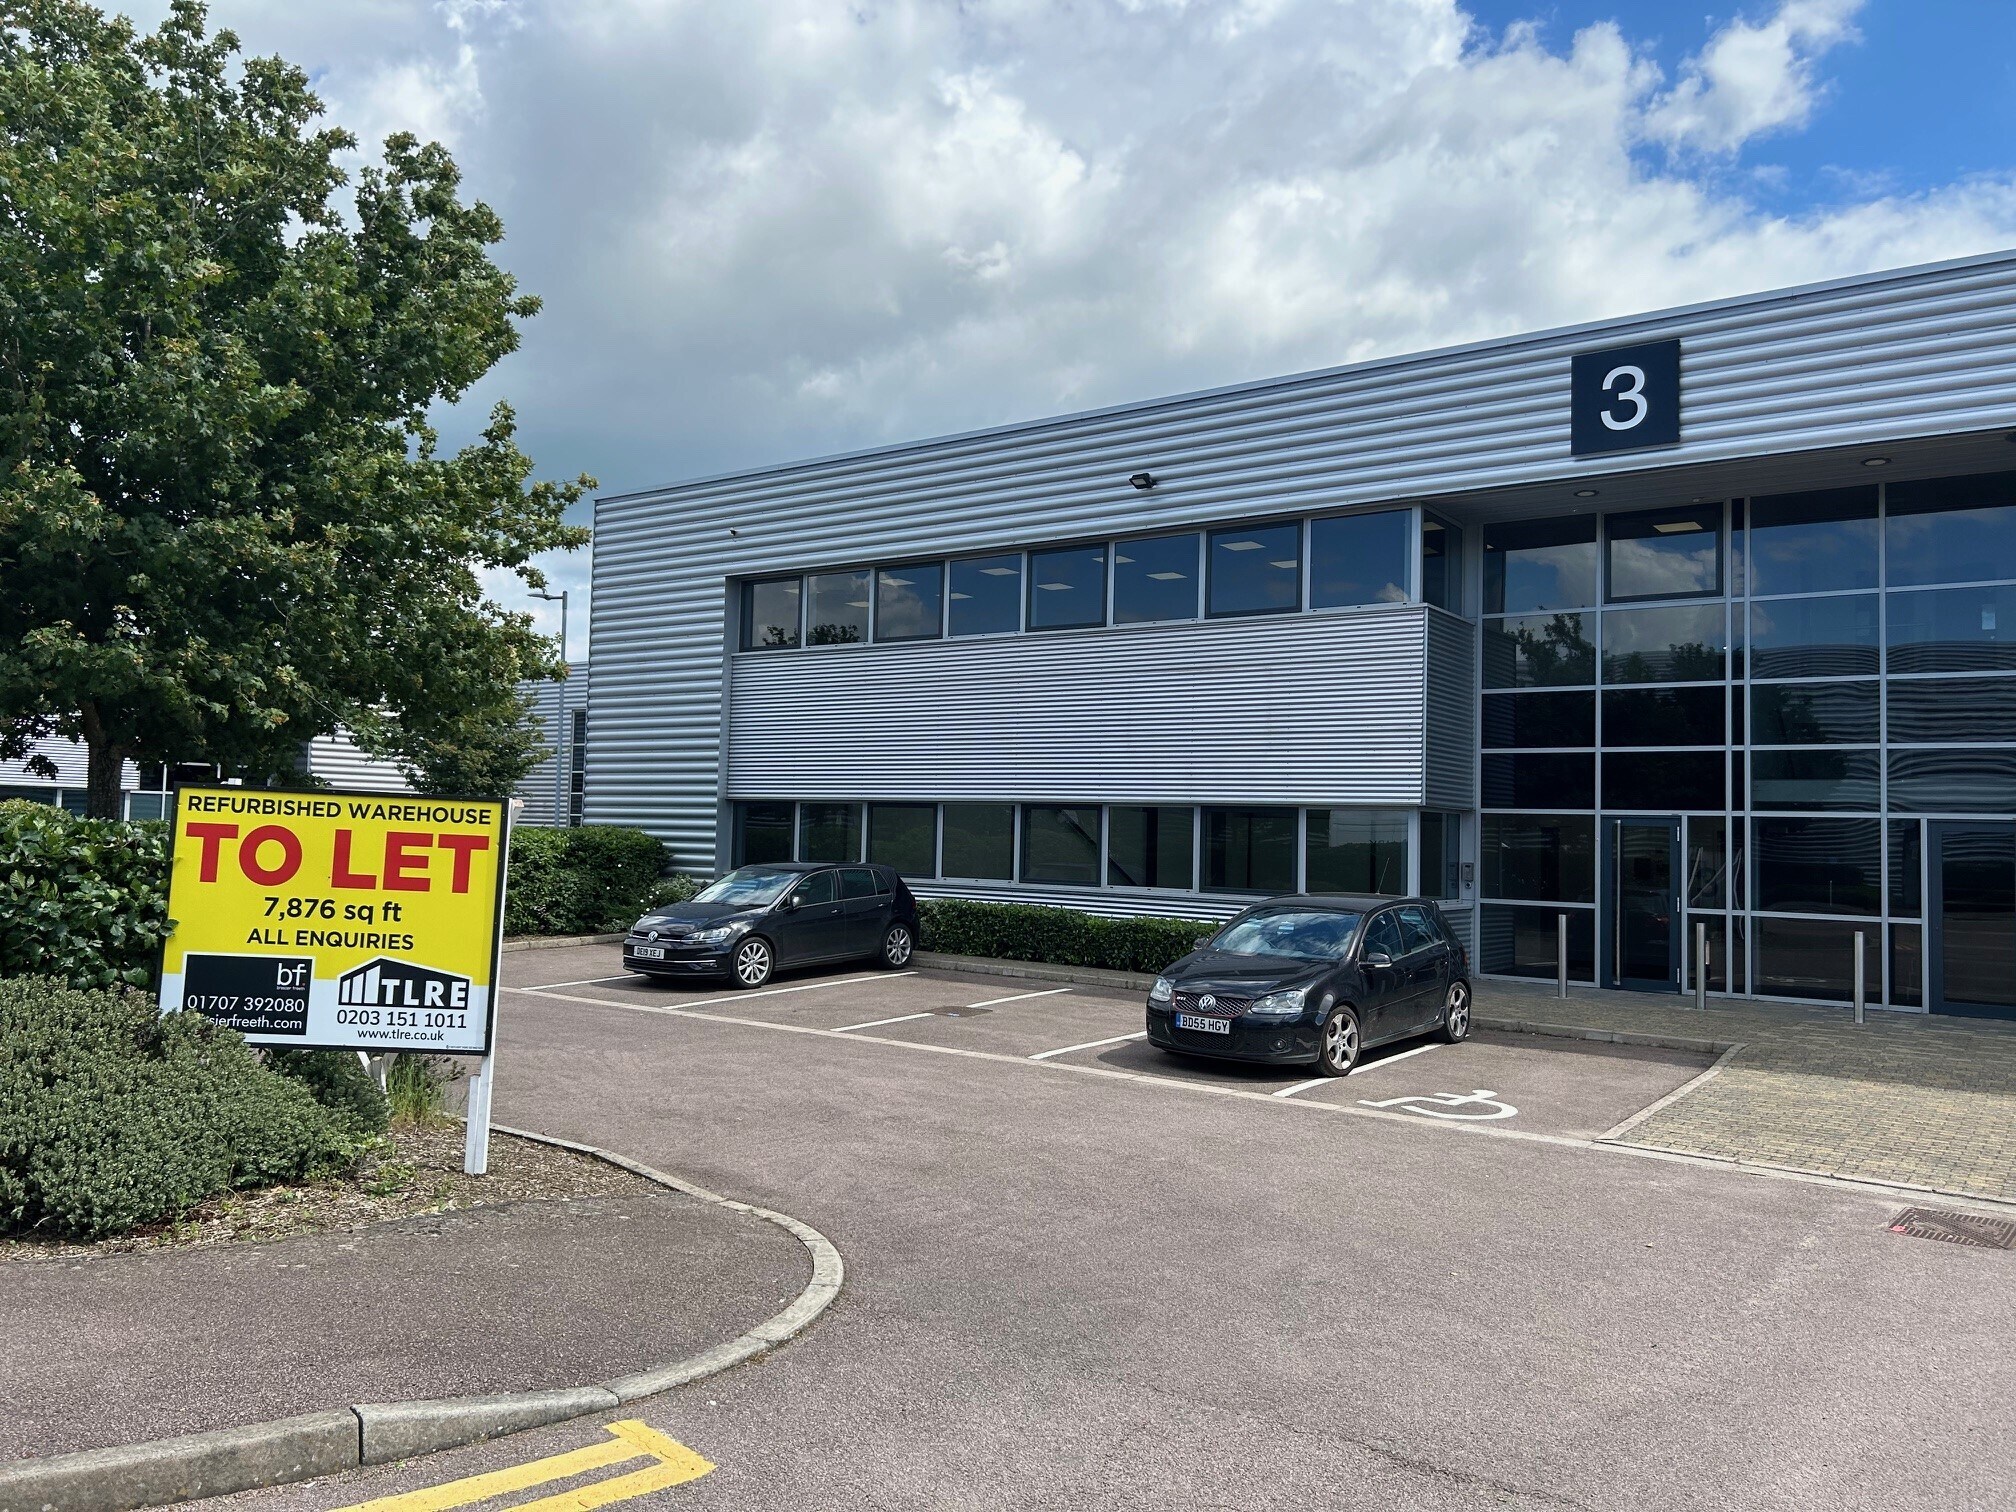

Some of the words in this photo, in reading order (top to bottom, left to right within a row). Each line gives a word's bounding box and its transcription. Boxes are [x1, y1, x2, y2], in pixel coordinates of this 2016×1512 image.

[1600, 365, 1648, 431] 3
[187, 795, 342, 818] REFURBISHED
[348, 802, 492, 825] WAREHOUSE
[185, 821, 303, 887] TO
[330, 828, 490, 894] LET
[263, 896, 336, 921] 7,876
[343, 904, 374, 925] sq
[382, 901, 403, 922] ft
[246, 927, 289, 946] ALL
[295, 930, 414, 951] ENQUIRIES
[187, 994, 239, 1010] 01707
[243, 996, 305, 1013] 392080
[381, 978, 467, 1008] TLRE
[336, 1009, 381, 1026] 0203
[386, 1011, 418, 1027] 151
[424, 1012, 467, 1029] 1011
[1182, 1016, 1206, 1030] BD55
[1208, 1019, 1228, 1032] HGY
[357, 1028, 445, 1041] www.tlre.co.uk
